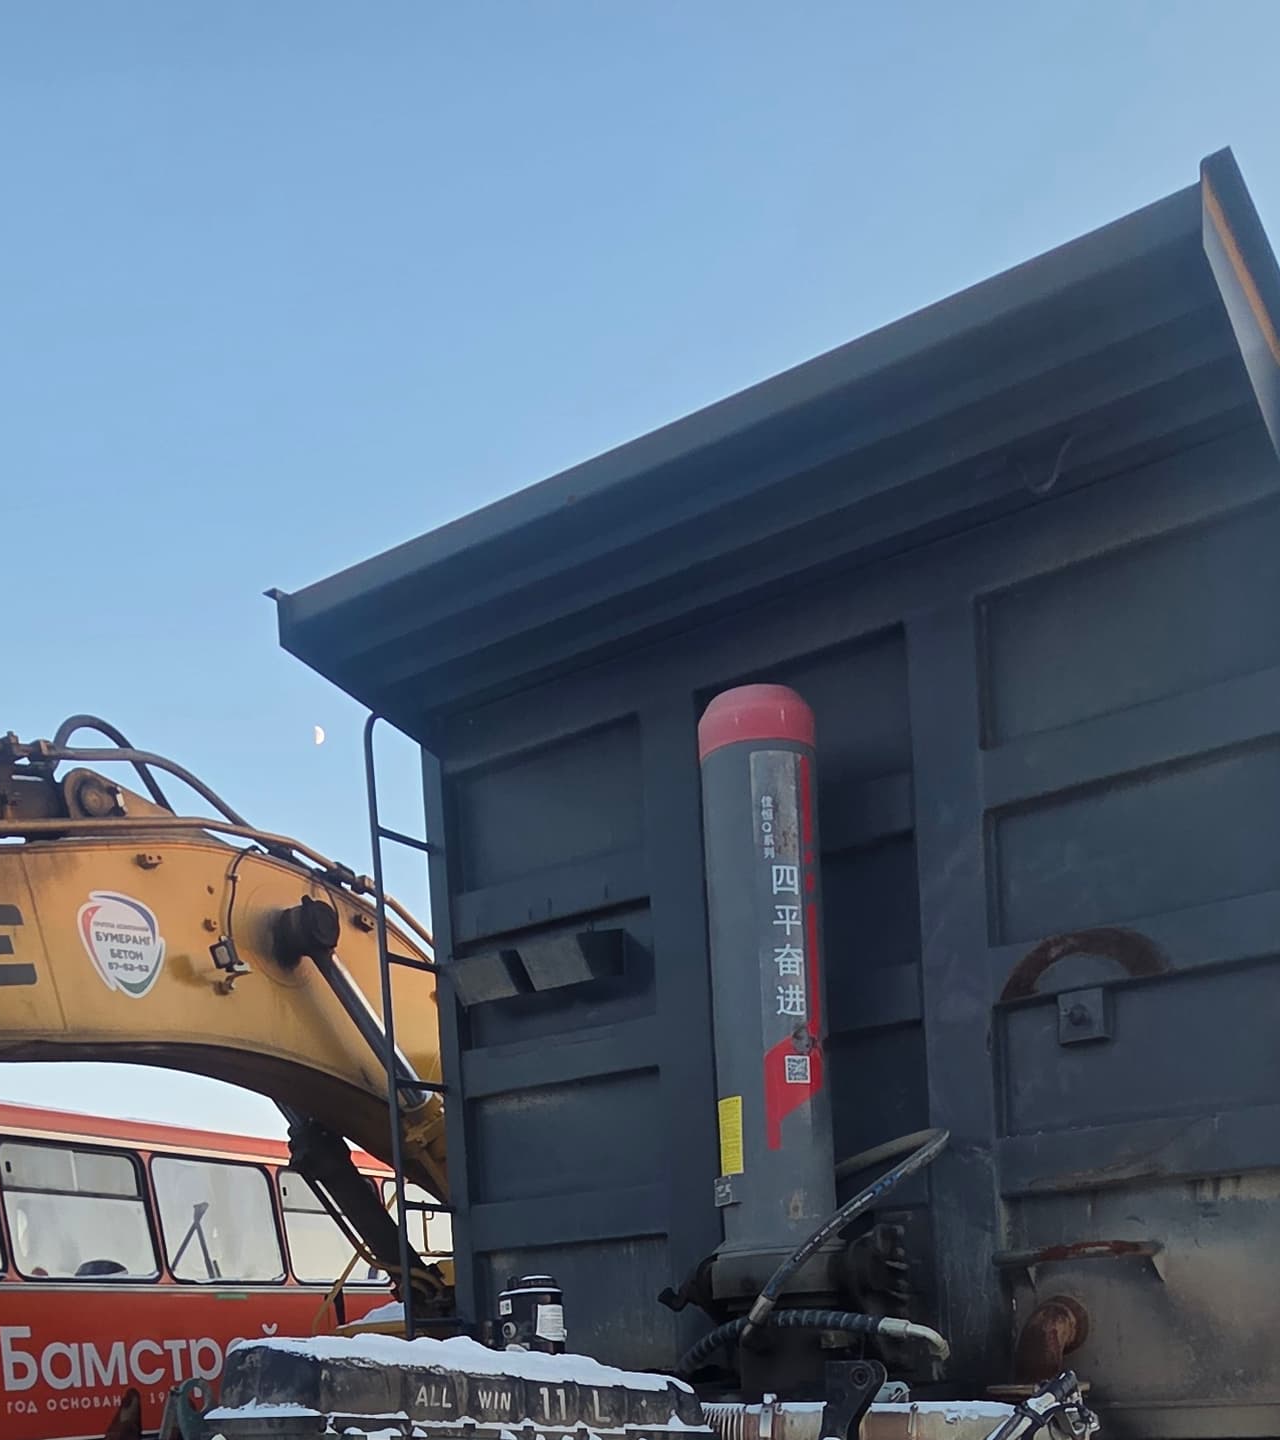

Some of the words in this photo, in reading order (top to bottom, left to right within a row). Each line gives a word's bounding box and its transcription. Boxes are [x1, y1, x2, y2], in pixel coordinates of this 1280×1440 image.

[95, 931, 151, 946] БУМЕРАНГ
[772, 865, 807, 1016] 四平奋进
[109, 948, 144, 961] БЕТОН
[7, 1401, 38, 1414] ГОД
[415, 1384, 453, 1409] ALL
[478, 1389, 512, 1411] WIN
[539, 1387, 568, 1421] 11
[592, 1389, 612, 1423] L
